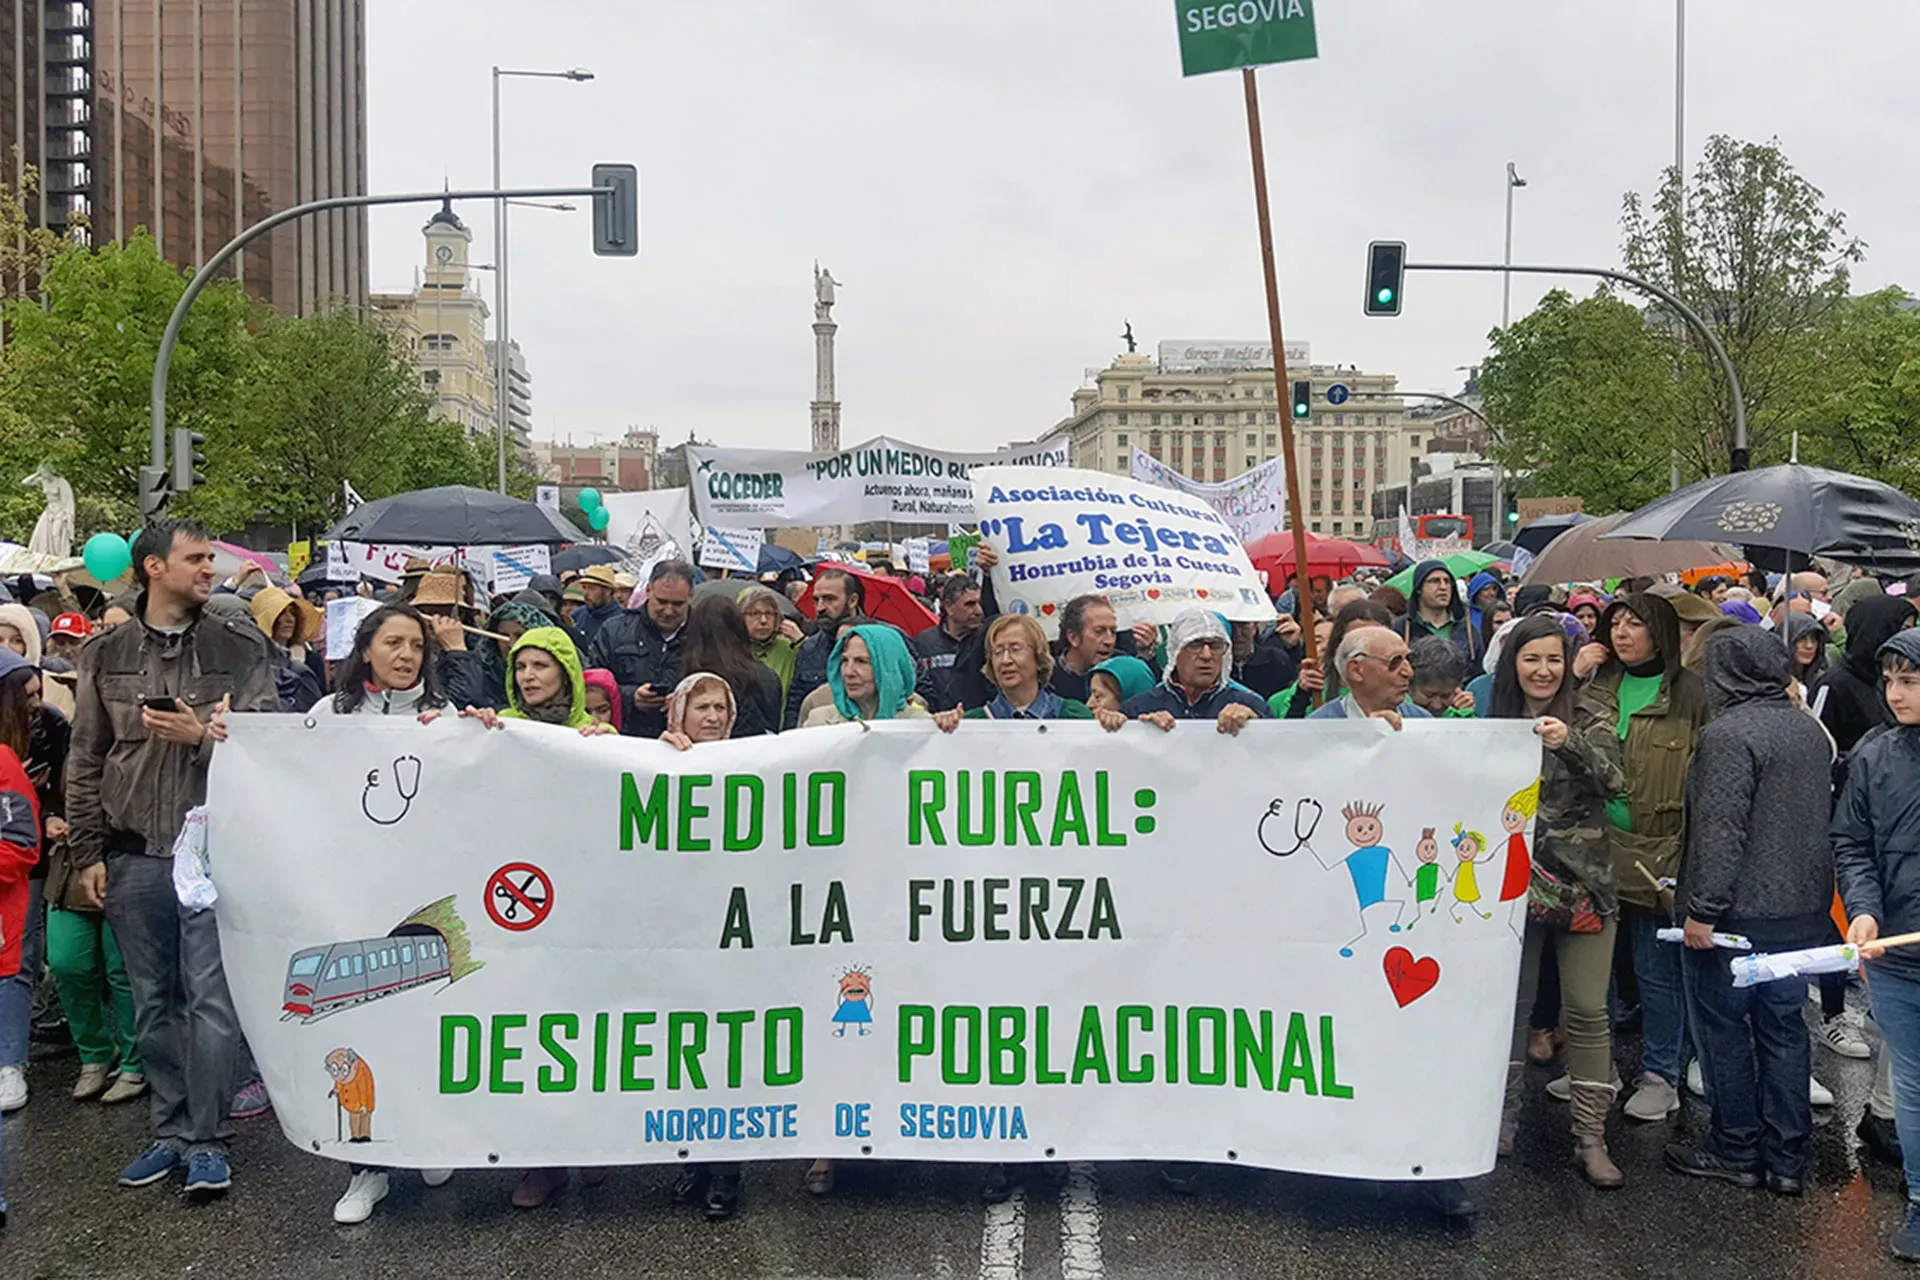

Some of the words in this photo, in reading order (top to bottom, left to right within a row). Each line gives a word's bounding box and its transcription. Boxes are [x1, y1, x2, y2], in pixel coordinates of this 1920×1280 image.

[1186, 0, 1305, 32] SEGOVIA
[857, 449, 882, 476] UN
[886, 450, 942, 477] MEDIO
[988, 486, 1122, 505] Asociación
[1129, 494, 1221, 524] Cultural
[1009, 553, 1117, 582] Honrubia
[1123, 553, 1147, 568] de
[1152, 554, 1172, 568] la
[1176, 556, 1242, 577] Cuesta
[1095, 571, 1172, 590] Segovia
[619, 771, 846, 852] MEDIO
[908, 769, 1157, 847] RURAL:
[719, 886, 754, 949] A
[790, 881, 854, 946] LA
[908, 877, 1123, 942] FUERZA
[439, 1005, 804, 1095] DESIERTO
[898, 1004, 1356, 1100] POBLACIONAL
[644, 1103, 798, 1143] NORDESTE
[835, 1103, 871, 1138] DE
[900, 1103, 1029, 1141] SEGOVIA
